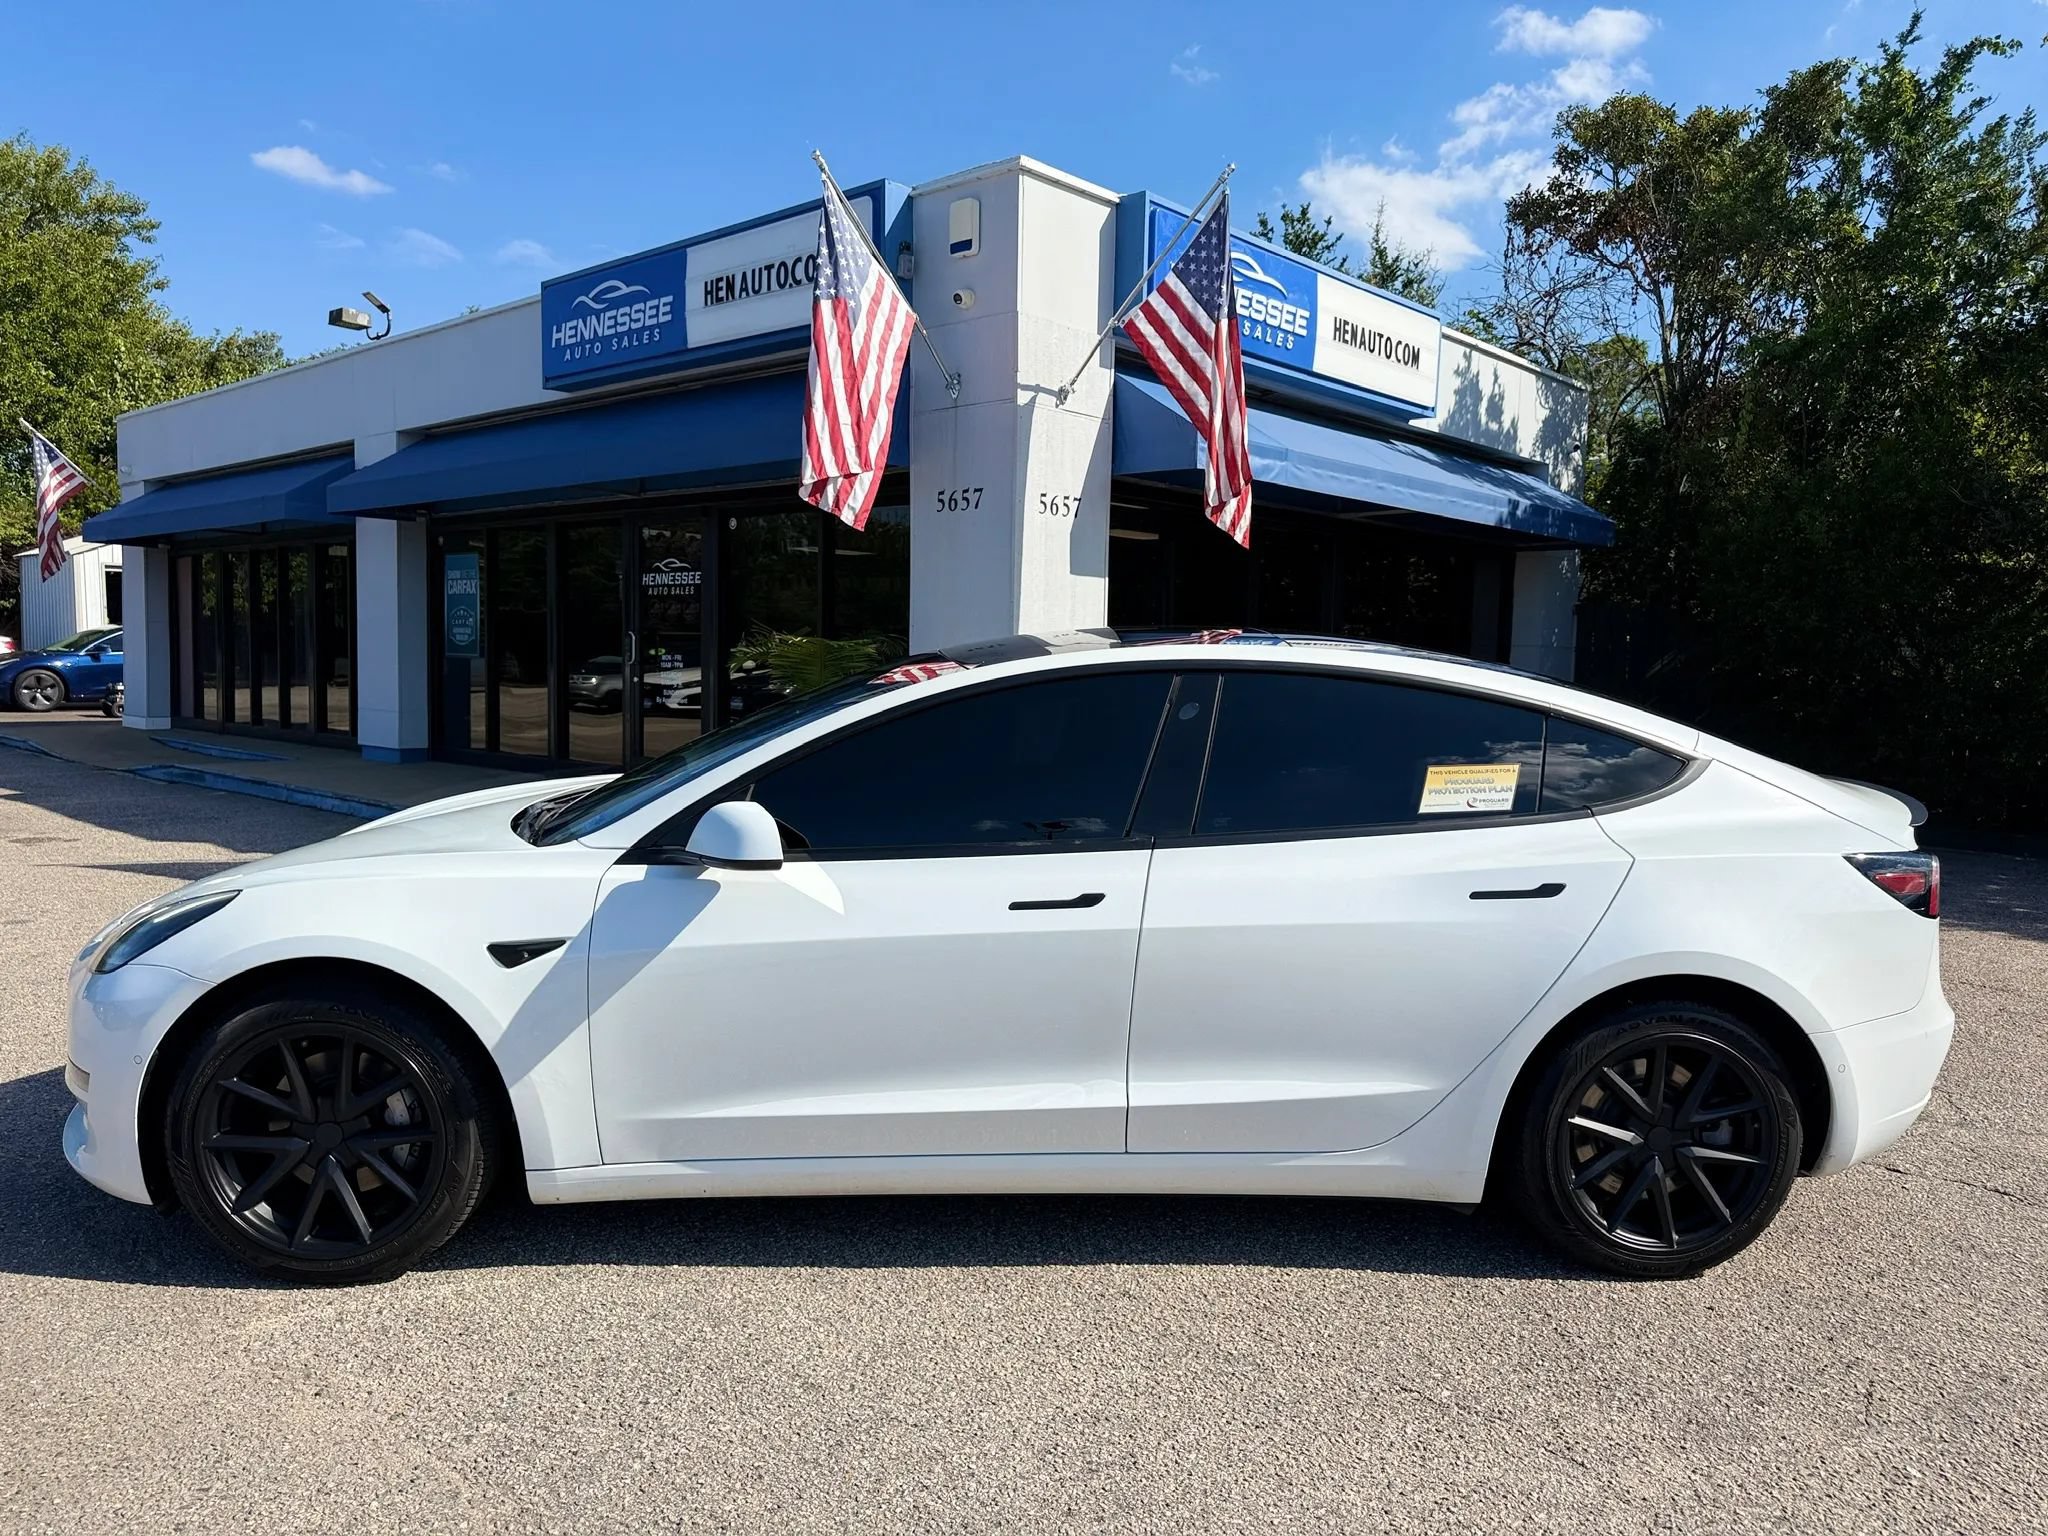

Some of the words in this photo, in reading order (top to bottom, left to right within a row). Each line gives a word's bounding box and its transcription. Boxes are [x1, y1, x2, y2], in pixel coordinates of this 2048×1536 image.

[704, 253, 817, 307] HENAUTO.CO
[551, 295, 674, 349] HENNESSEE
[1234, 285, 1311, 337] ESSEE
[564, 342, 602, 361] AUTO
[611, 328, 660, 350] SALES
[1242, 320, 1295, 350] SALES
[936, 487, 984, 513] 5657
[1038, 492, 1082, 518] 5657
[447, 579, 477, 594] CARFAX
[642, 572, 702, 585] HENNESSEE
[647, 586, 669, 596] AUTO
[671, 585, 695, 595] SALES
[1428, 786, 1487, 796] PROTECTION
[1488, 785, 1513, 794] PLAN
